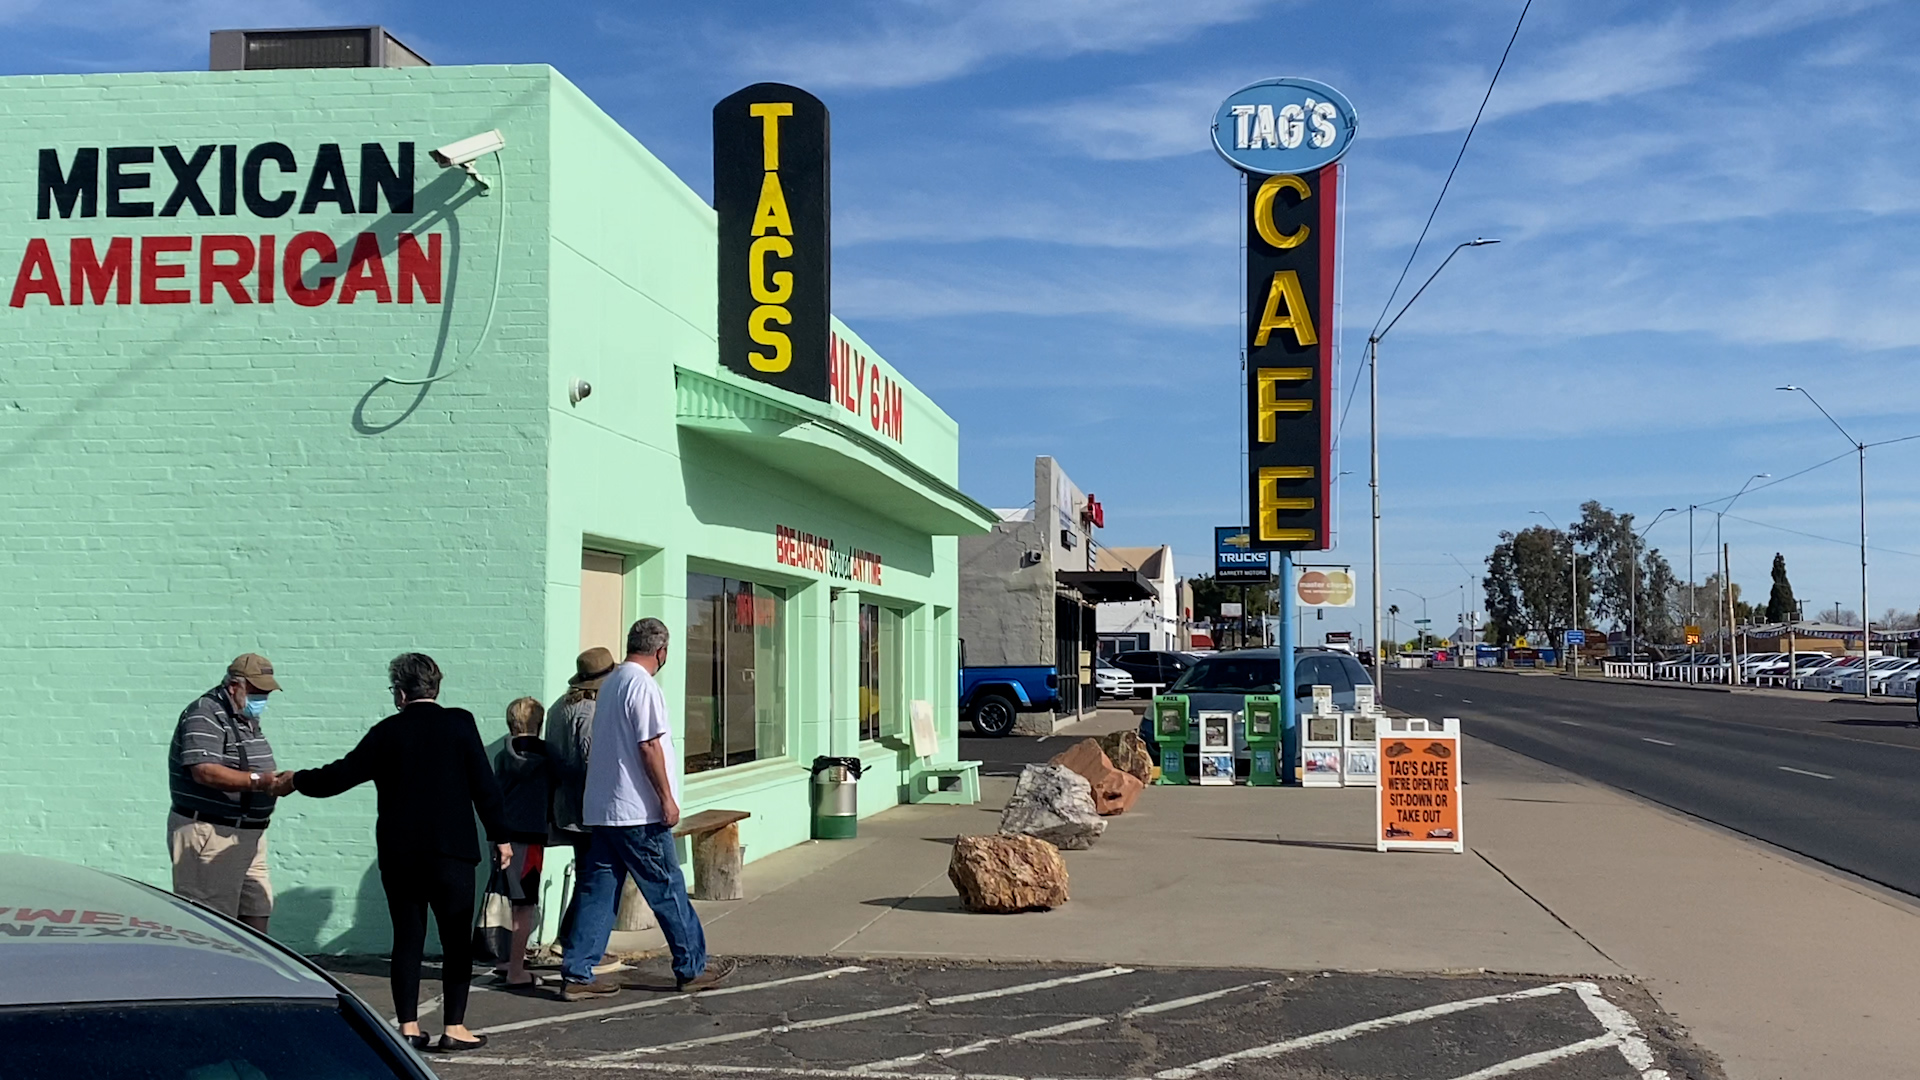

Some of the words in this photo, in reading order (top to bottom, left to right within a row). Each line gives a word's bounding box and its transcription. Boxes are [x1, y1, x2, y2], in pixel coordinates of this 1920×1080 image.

[1231, 97, 1337, 149] TAG'S
[36, 141, 416, 220] MEXICAN
[747, 102, 794, 373] TAGS
[9, 231, 442, 309] AMERICAN
[1254, 174, 1318, 542] CAFE
[830, 330, 865, 417] AILY
[870, 363, 880, 432] 6
[882, 375, 903, 445] AM
[776, 524, 828, 575] BREAKFAST
[852, 548, 882, 586] ANYTIME
[1219, 552, 1267, 563] TRUCKS
[1388, 777, 1411, 791] WE'RE
[1412, 777, 1432, 791] OPEN
[1434, 778, 1449, 791] FOR
[1389, 761, 1419, 776] TAG'S
[1421, 761, 1448, 777] CAFE
[1390, 793, 1433, 807] SIT-DOWN
[1435, 794, 1448, 807] OR
[1397, 809, 1420, 822] TAKE
[1422, 810, 1441, 823] OUT
